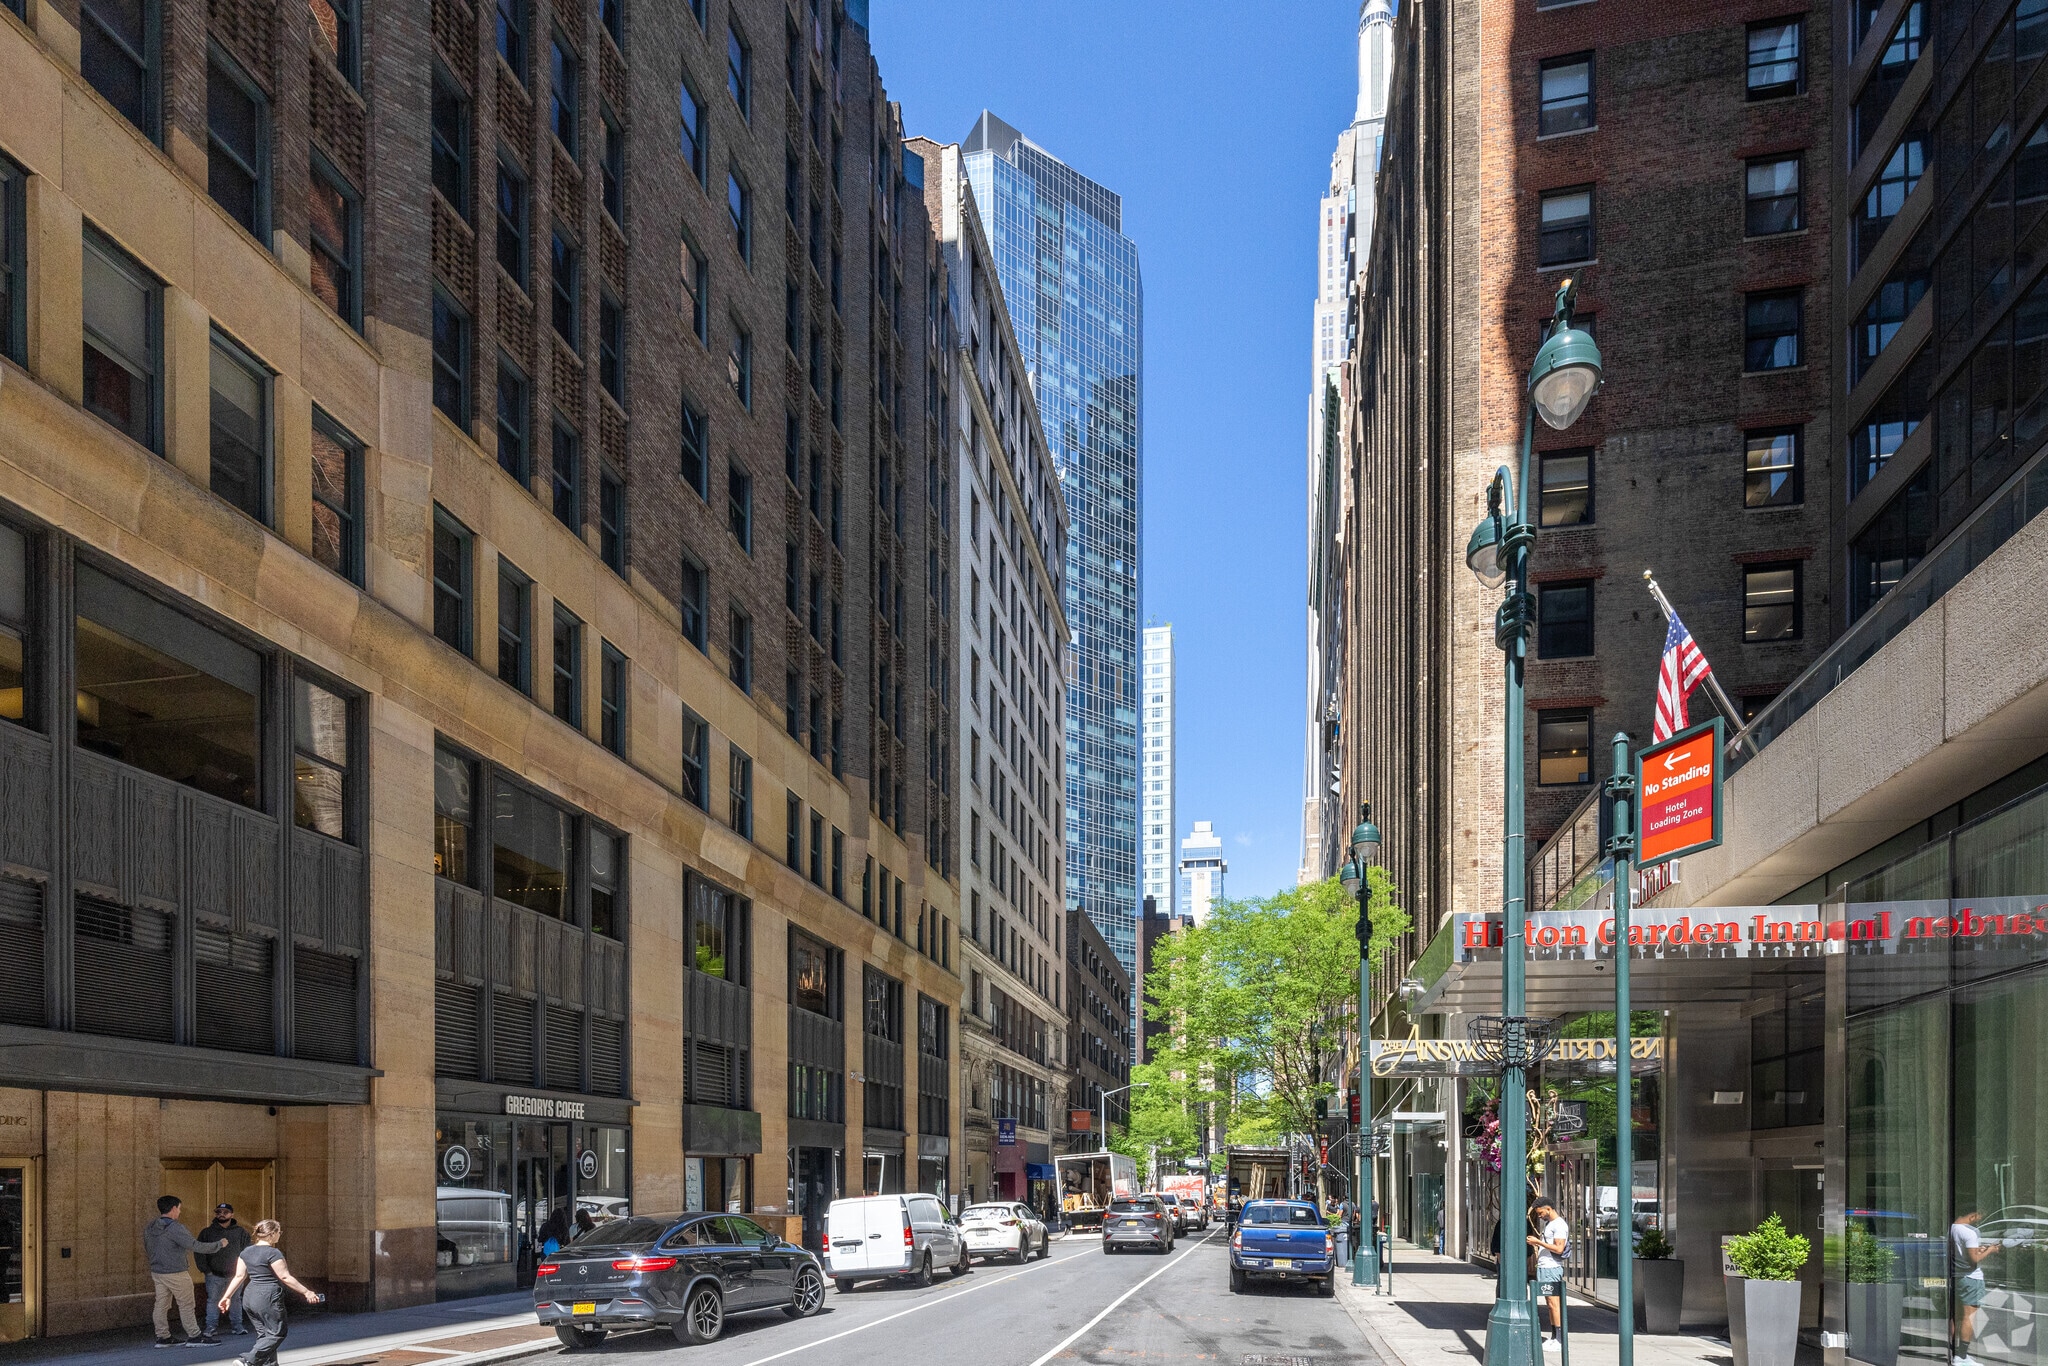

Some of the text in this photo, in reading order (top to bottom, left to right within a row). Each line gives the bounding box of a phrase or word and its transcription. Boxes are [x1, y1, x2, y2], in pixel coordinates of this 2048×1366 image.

[1645, 763, 1711, 797] No Standing
[1650, 806, 1703, 831] Loading Zone
[1665, 799, 1687, 814] Hotel
[1463, 919, 1588, 948] Hiton
[1753, 914, 1826, 943] Inn
[506, 1095, 585, 1120] GREGORYS COFFEE
